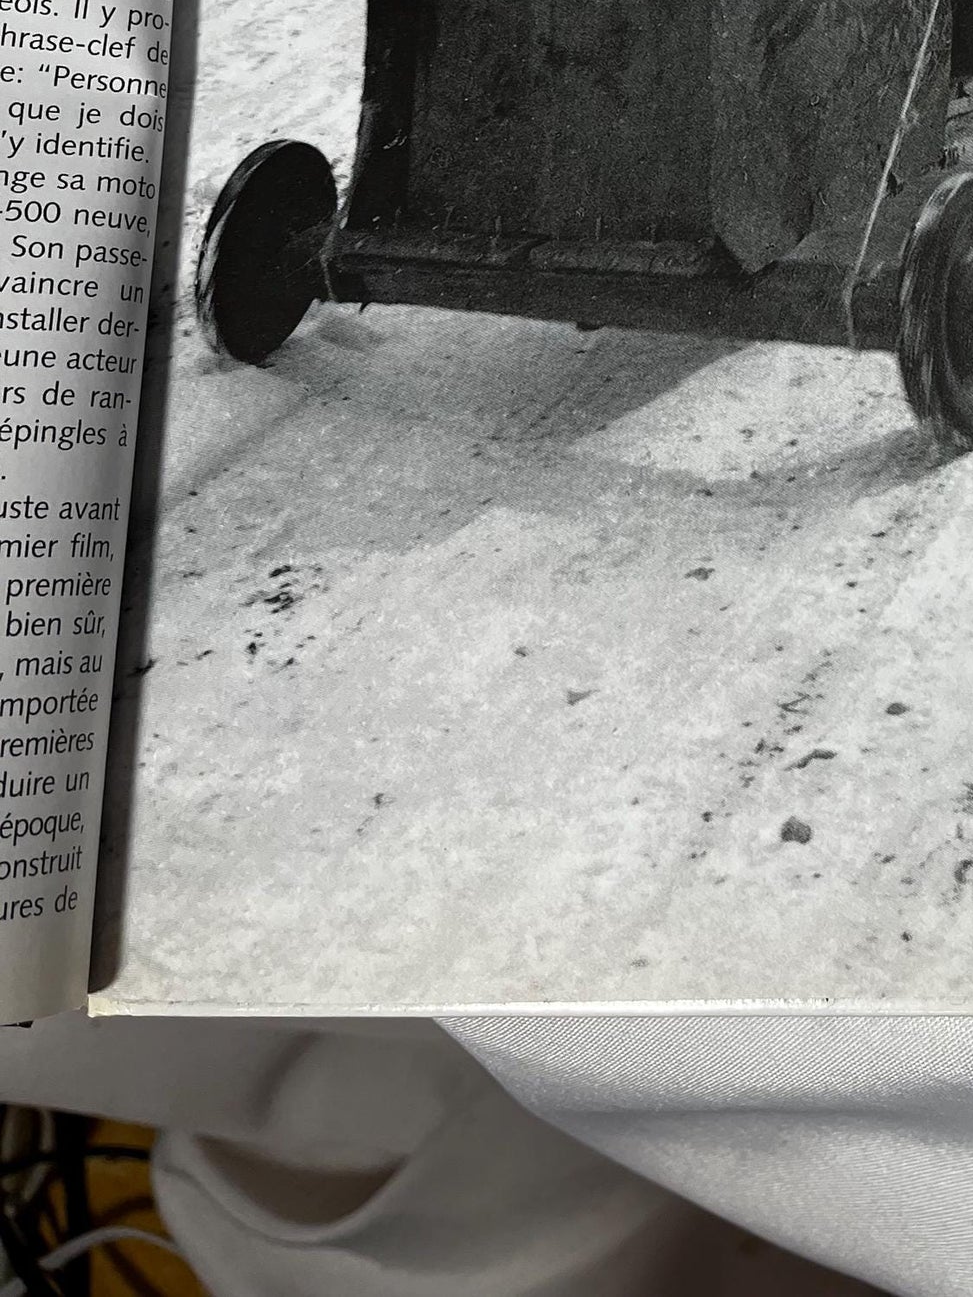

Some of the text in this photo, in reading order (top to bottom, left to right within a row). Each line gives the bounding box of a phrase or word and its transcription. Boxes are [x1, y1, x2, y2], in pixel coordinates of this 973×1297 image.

[100, 6, 116, 28] y
[127, 7, 170, 32] pro-
[0, 23, 168, 66] hrase-clef de
[0, 65, 24, 84] e:
[8, 102, 164, 132] que je dois
[36, 132, 150, 164] identifie.
[57, 172, 86, 191] sa
[97, 175, 156, 200] moto
[11, 235, 148, 268] Son passe-
[120, 284, 144, 304] un
[98, 312, 140, 338] der-
[0, 348, 137, 374] une acteur
[3, 381, 132, 410] rs de ran-
[0, 418, 128, 450] épingles à
[59, 498, 120, 521] avant
[70, 532, 114, 561] film,
[6, 571, 112, 606] première
[6, 610, 106, 638] bien sûr,
[16, 650, 73, 677] mais
[80, 655, 103, 674] au
[0, 688, 99, 724] mportée
[0, 729, 94, 758] remières
[66, 772, 90, 792] un
[0, 811, 85, 846] époque,
[55, 885, 78, 912] de
